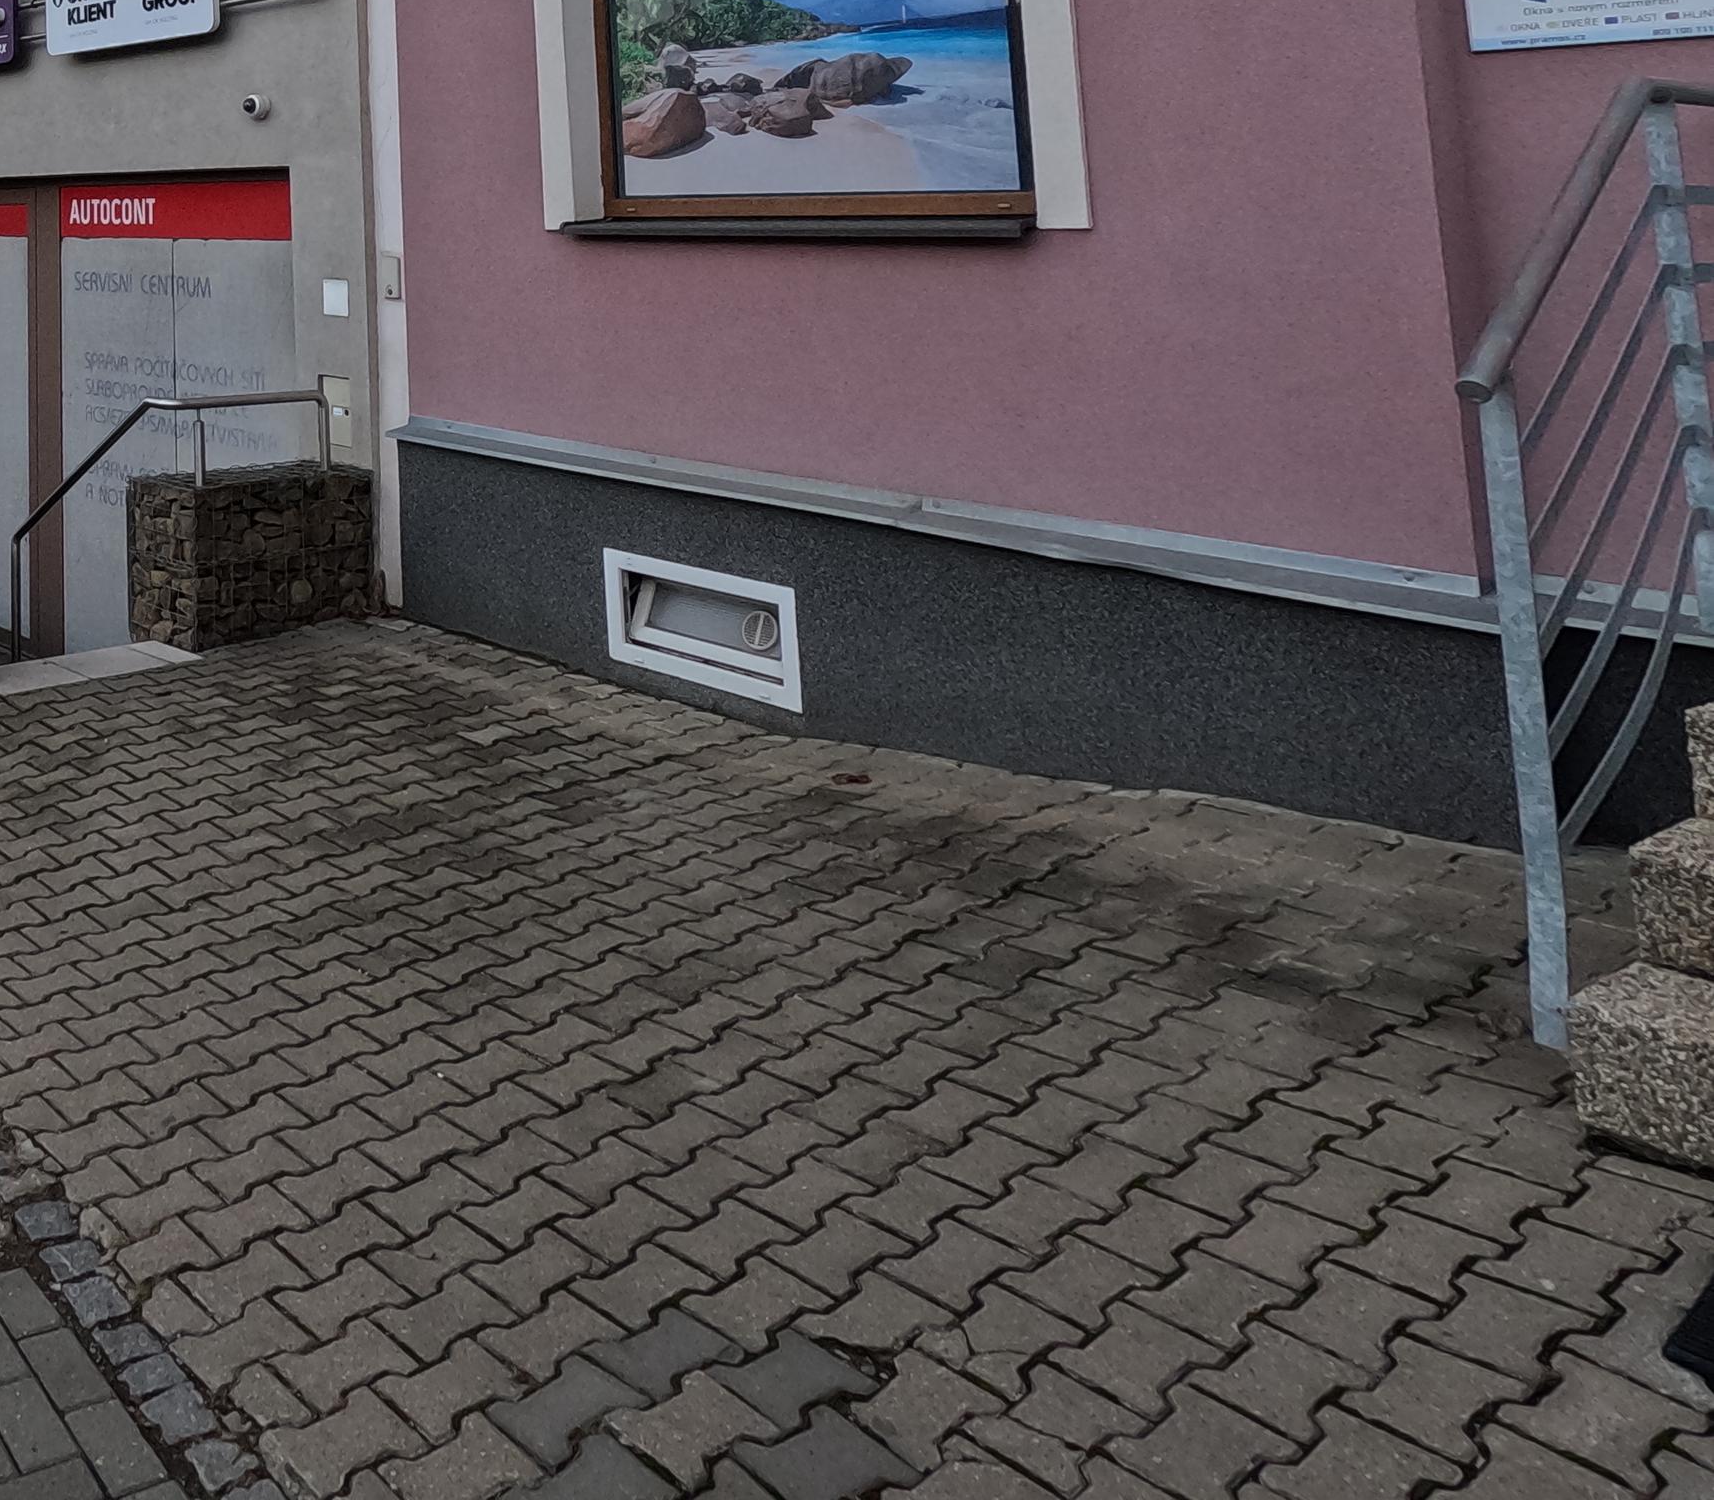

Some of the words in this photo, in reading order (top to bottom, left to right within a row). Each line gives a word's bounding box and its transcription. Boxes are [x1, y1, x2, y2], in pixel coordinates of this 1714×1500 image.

[67, 0, 117, 26] KLIENT
[1523, 6, 1554, 16] Okna
[1510, 22, 1541, 33] OKNA
[69, 197, 156, 226] AUTOCONT
[74, 268, 133, 293] SERVISNÍ
[140, 273, 212, 299] CENTRUM
